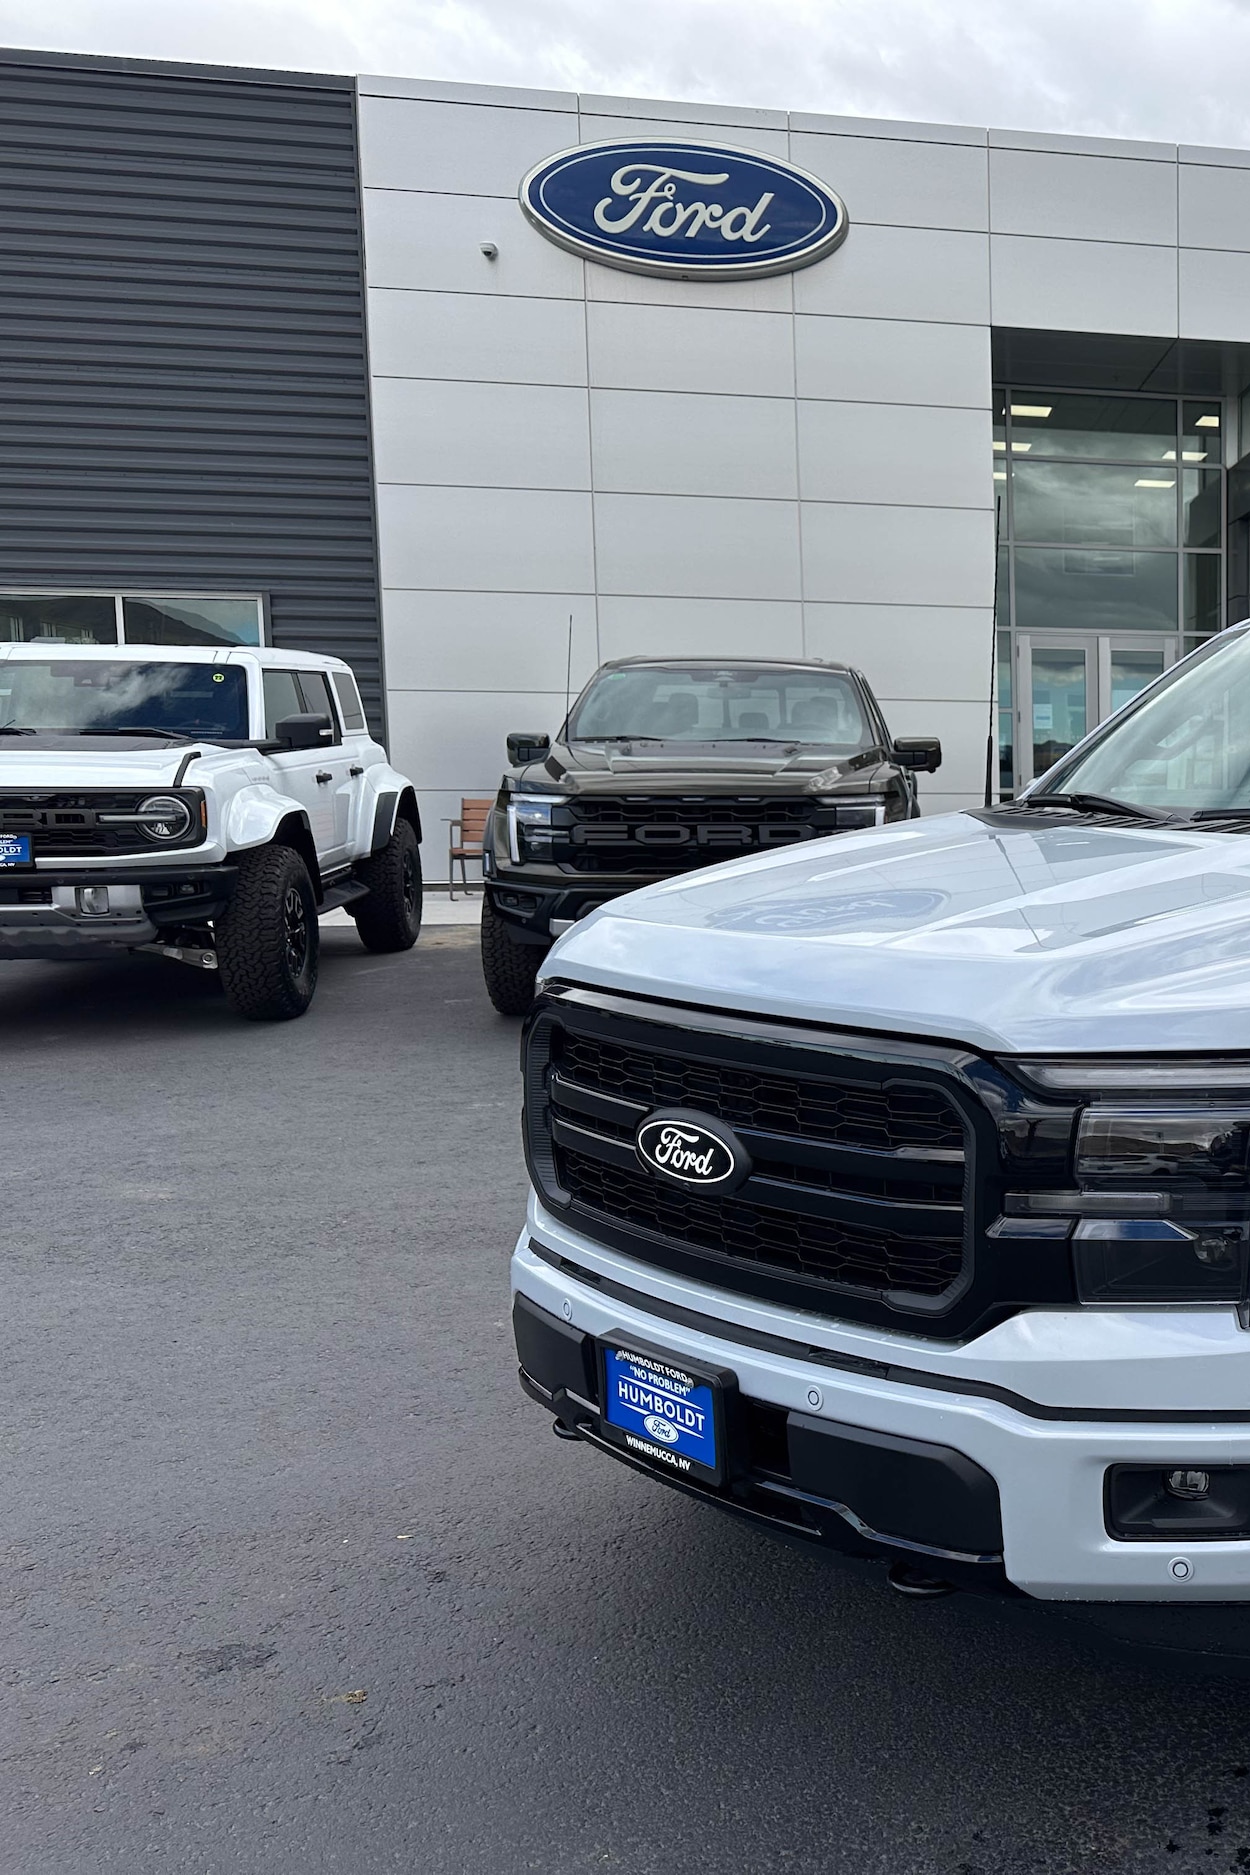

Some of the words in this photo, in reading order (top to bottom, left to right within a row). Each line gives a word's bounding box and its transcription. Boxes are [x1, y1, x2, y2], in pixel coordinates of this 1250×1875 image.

[594, 163, 775, 243] Ford
[571, 824, 818, 845] FORD
[655, 1127, 715, 1176] Ford
[621, 1350, 664, 1374] HUMBOLDT
[665, 1366, 687, 1383] FORD
[629, 1365, 647, 1380] “NO
[648, 1372, 691, 1397] PROBLEM”
[618, 1381, 705, 1432] HUMBOLDT
[651, 1419, 671, 1438] Ford
[626, 1434, 678, 1467] WINNEMUCCA,
[679, 1458, 691, 1471] NV
